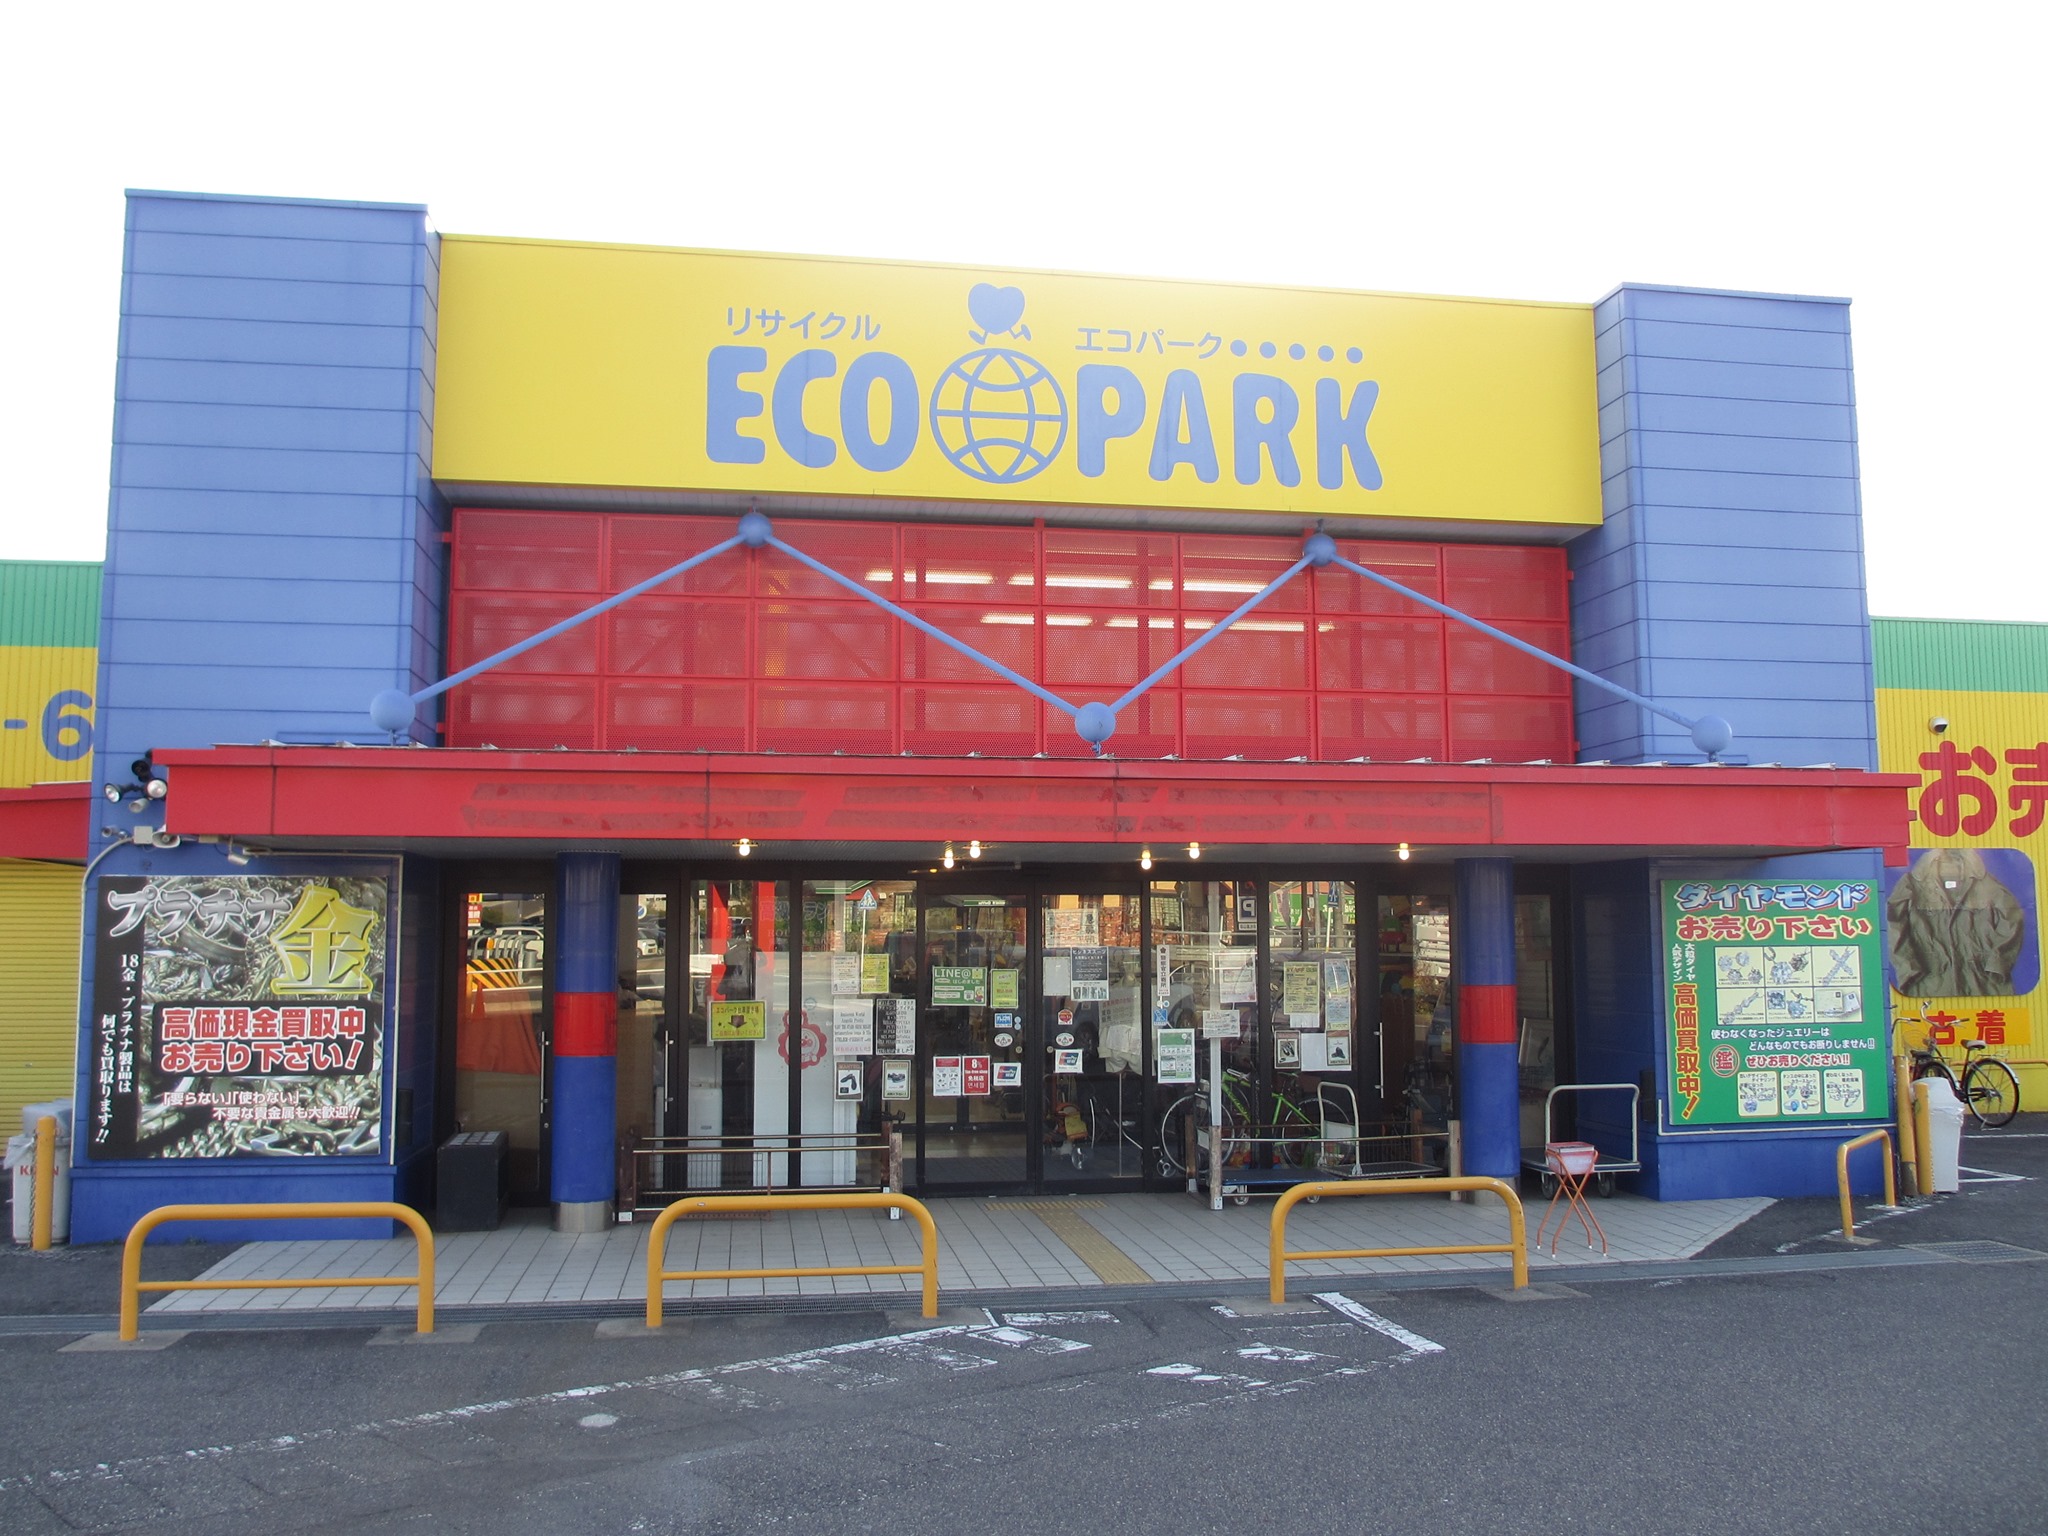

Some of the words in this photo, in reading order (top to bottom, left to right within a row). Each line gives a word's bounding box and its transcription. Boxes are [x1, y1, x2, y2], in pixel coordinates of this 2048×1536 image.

[726, 307, 881, 341] リサイクル
[706, 345, 919, 473] ECO
[1076, 363, 1383, 491] PARK
[107, 885, 292, 939] プラチナ
[1675, 882, 1871, 911] ダイヤモンド
[270, 884, 378, 995] 金
[1676, 914, 1873, 941] お売り下さい
[934, 968, 971, 979] LINE@
[161, 1006, 366, 1041] 高価現金買取中
[1711, 1028, 1830, 1040] 使わなくなったジュエリーは
[1925, 1010, 2006, 1046] 古着
